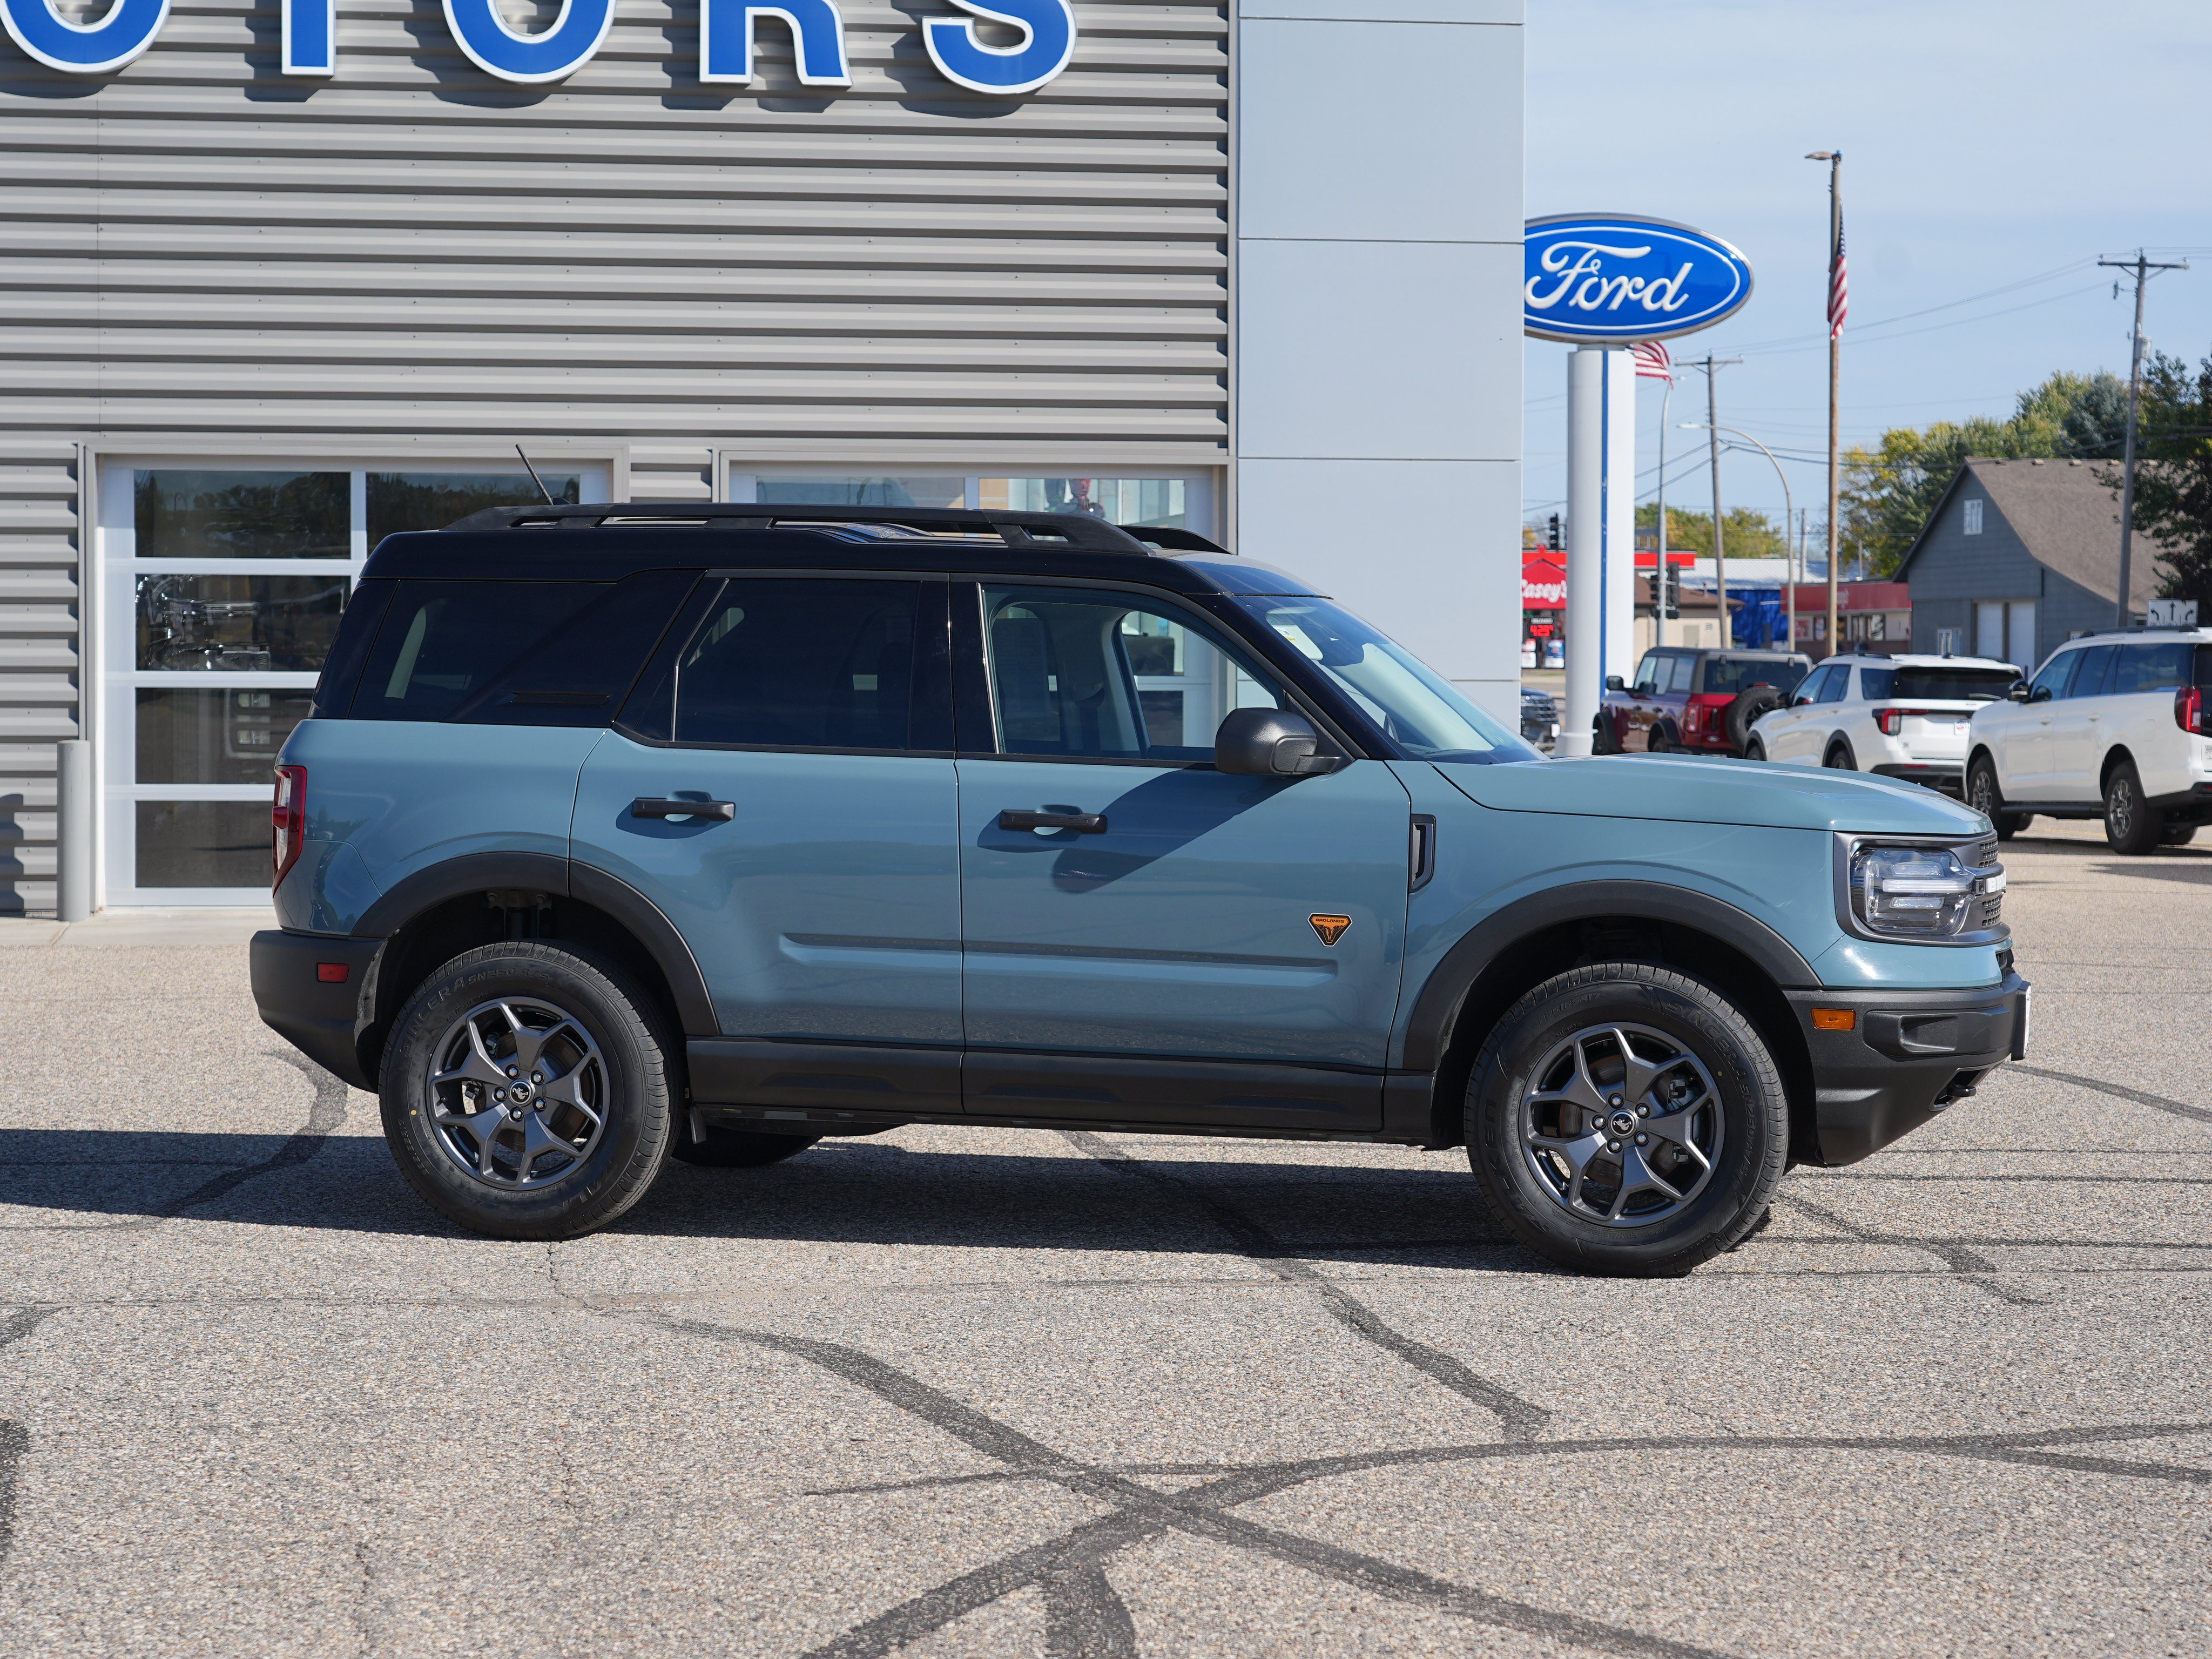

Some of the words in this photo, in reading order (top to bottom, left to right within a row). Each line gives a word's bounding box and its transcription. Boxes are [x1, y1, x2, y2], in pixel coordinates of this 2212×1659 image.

[1525, 241, 1694, 311] Ford
[400, 976, 466, 1057] SINCERA
[1666, 1000, 1749, 1082] SINCERA
[1739, 1083, 1757, 1138] SN250
